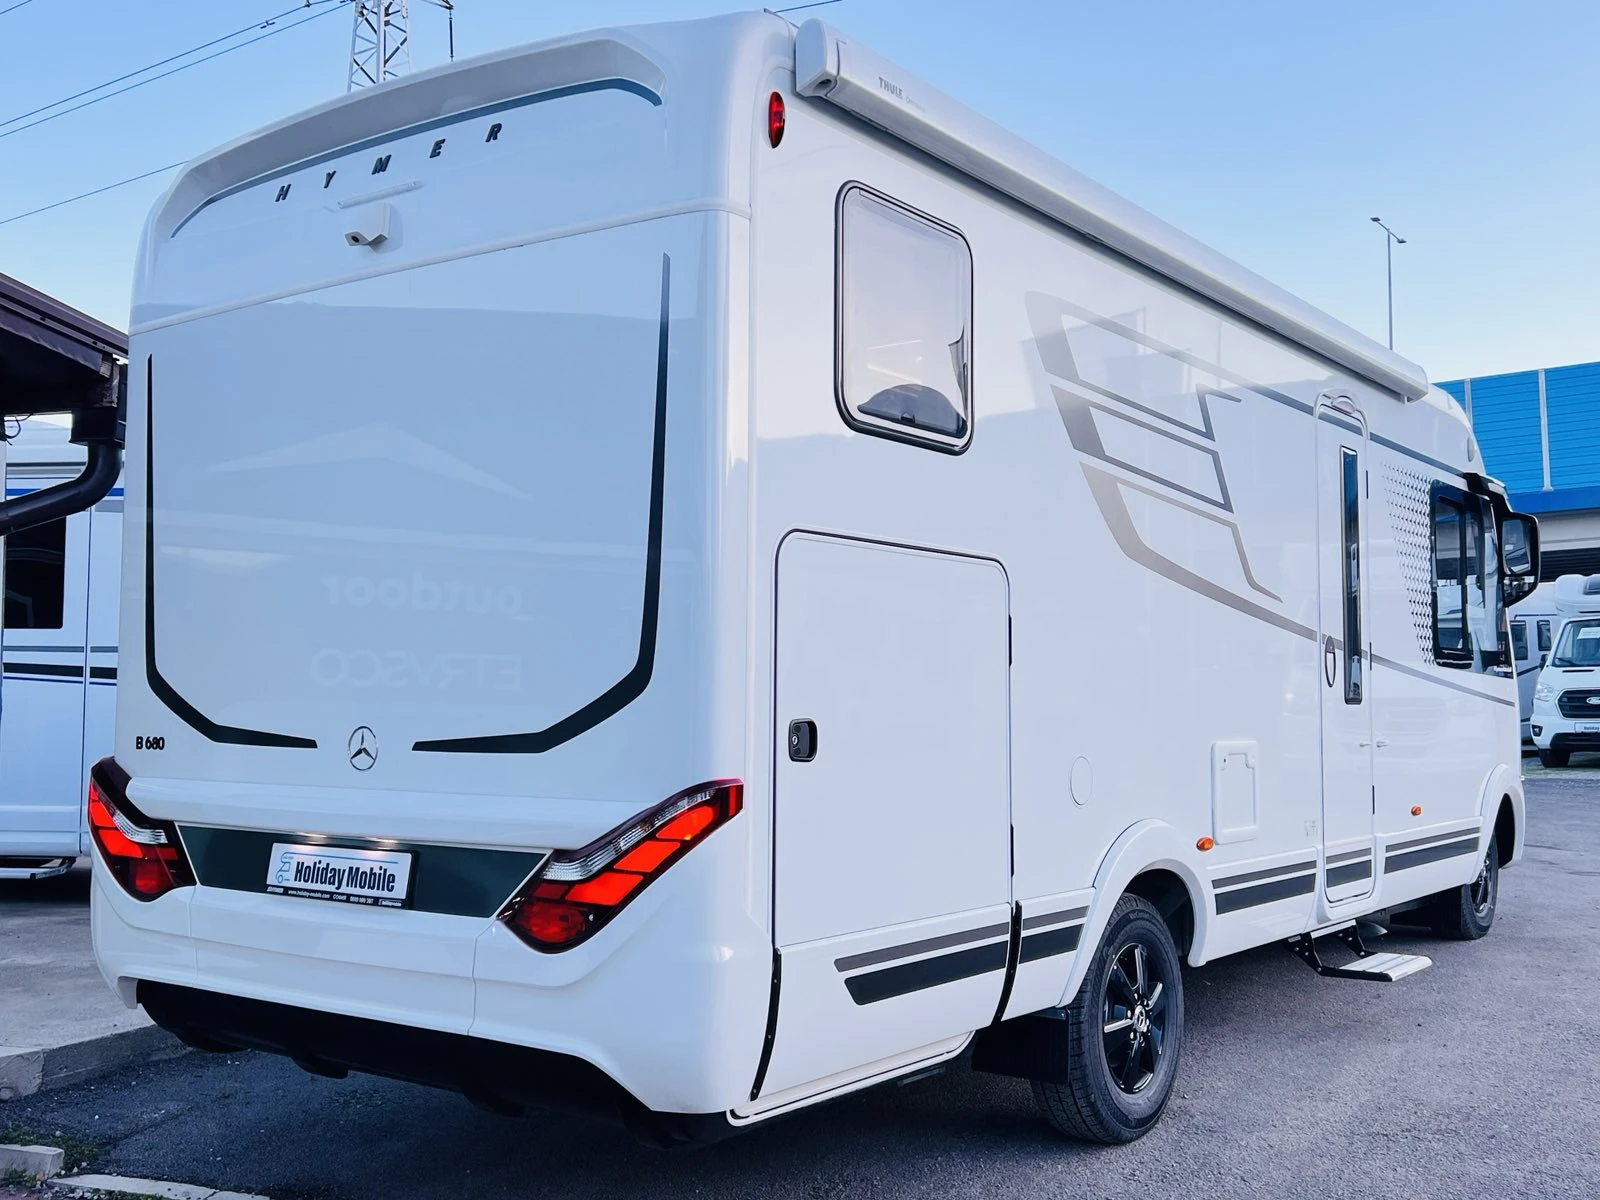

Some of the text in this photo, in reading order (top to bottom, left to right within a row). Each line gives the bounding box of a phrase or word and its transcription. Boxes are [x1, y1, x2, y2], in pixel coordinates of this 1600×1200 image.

[878, 76, 903, 99] THULE
[275, 123, 502, 202] HYMER
[136, 736, 165, 750] B 680
[294, 860, 396, 892] Holiday Mobile
